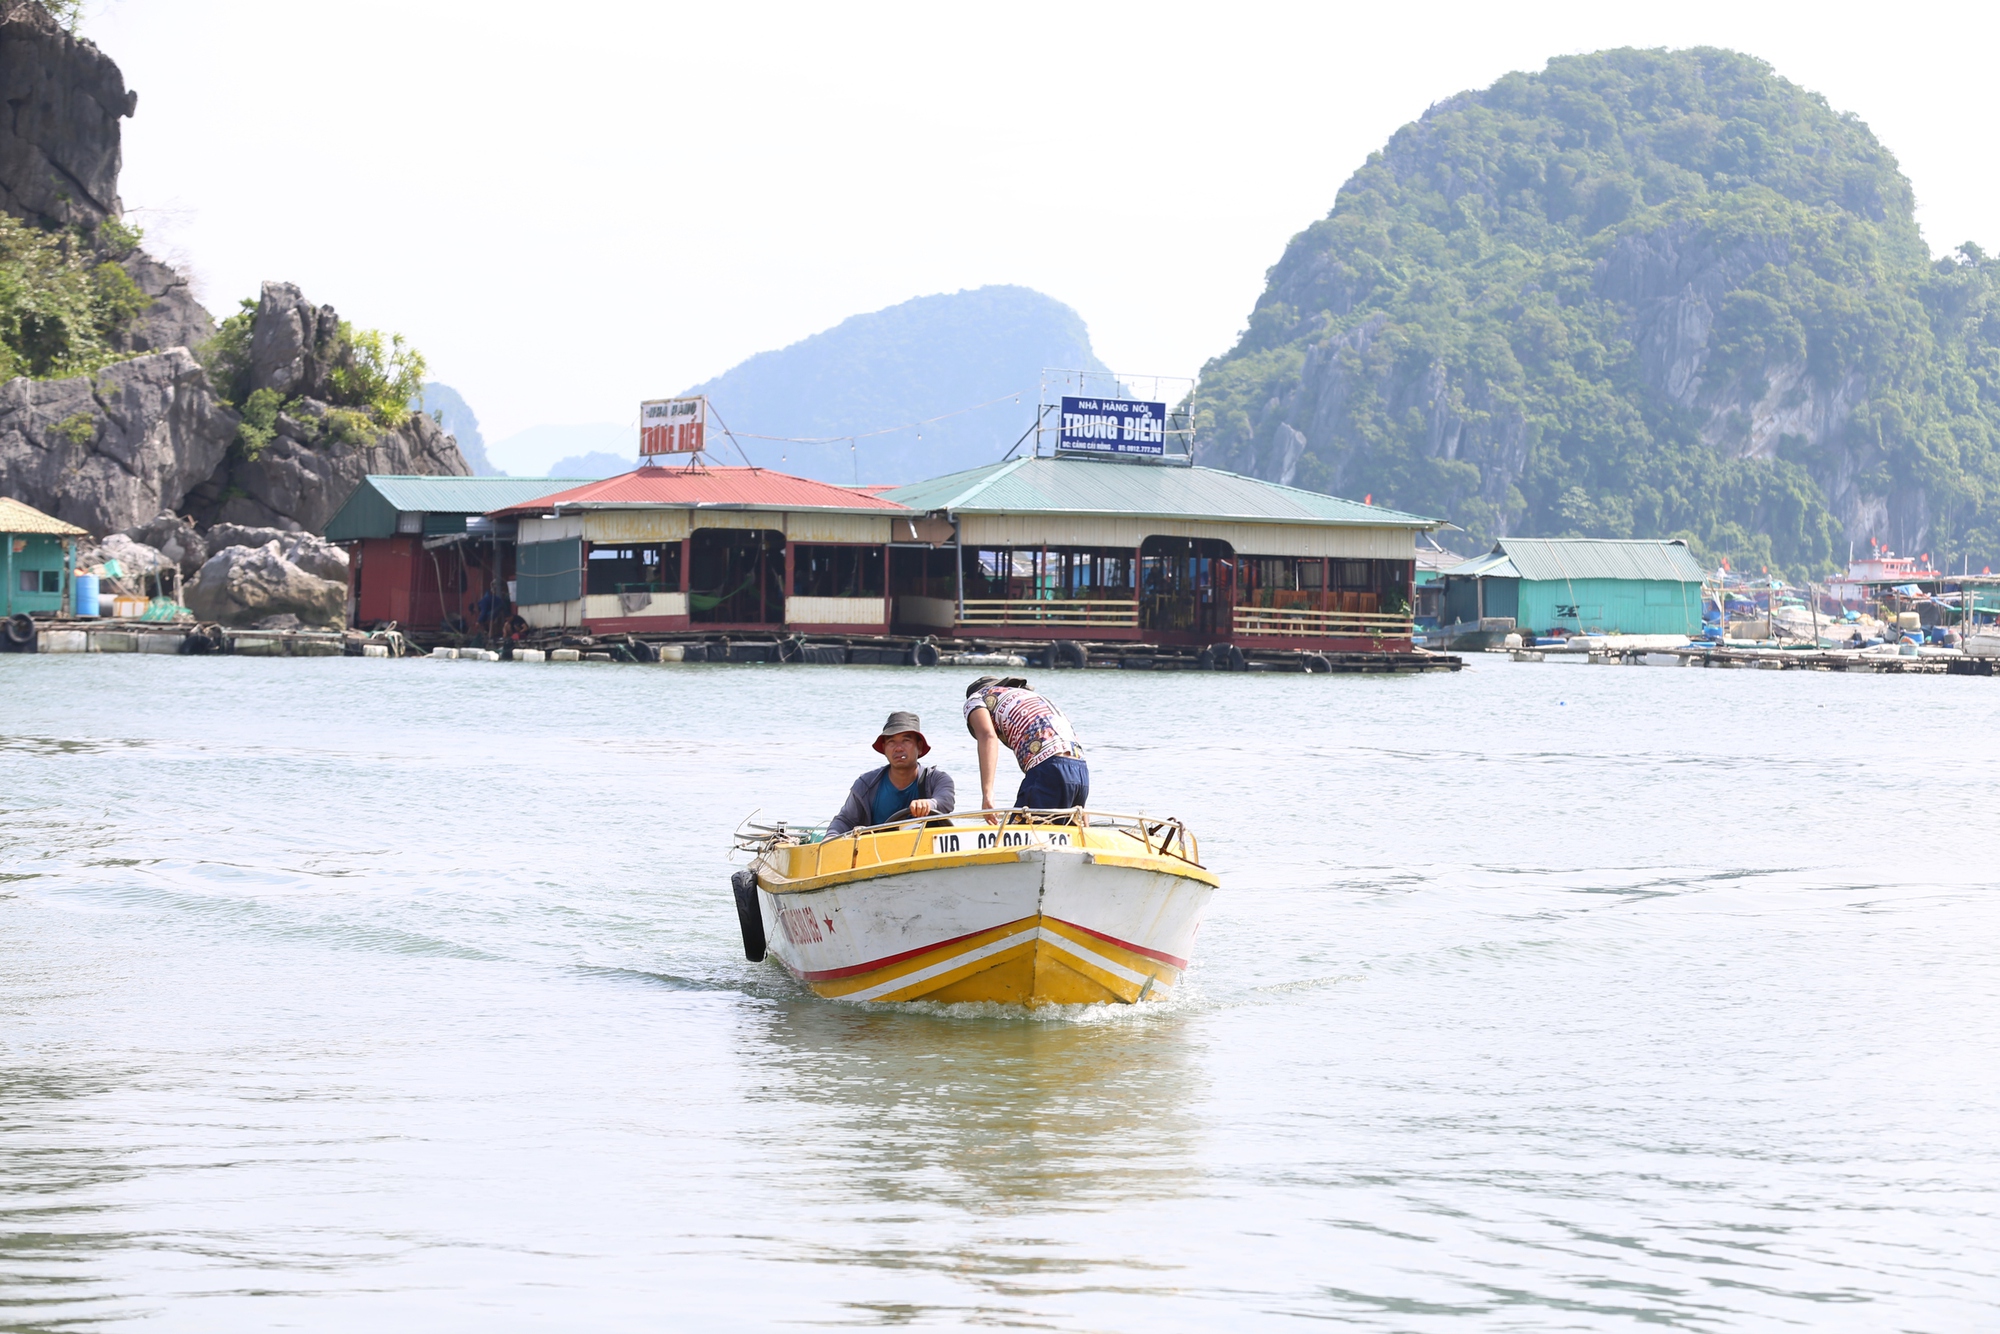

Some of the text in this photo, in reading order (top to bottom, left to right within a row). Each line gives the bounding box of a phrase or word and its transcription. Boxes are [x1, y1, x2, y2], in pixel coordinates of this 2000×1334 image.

[1079, 400, 1098, 410] NHÀ
[1102, 401, 1129, 412] HÀNG
[1063, 411, 1162, 442] TRUNG BIỂN
